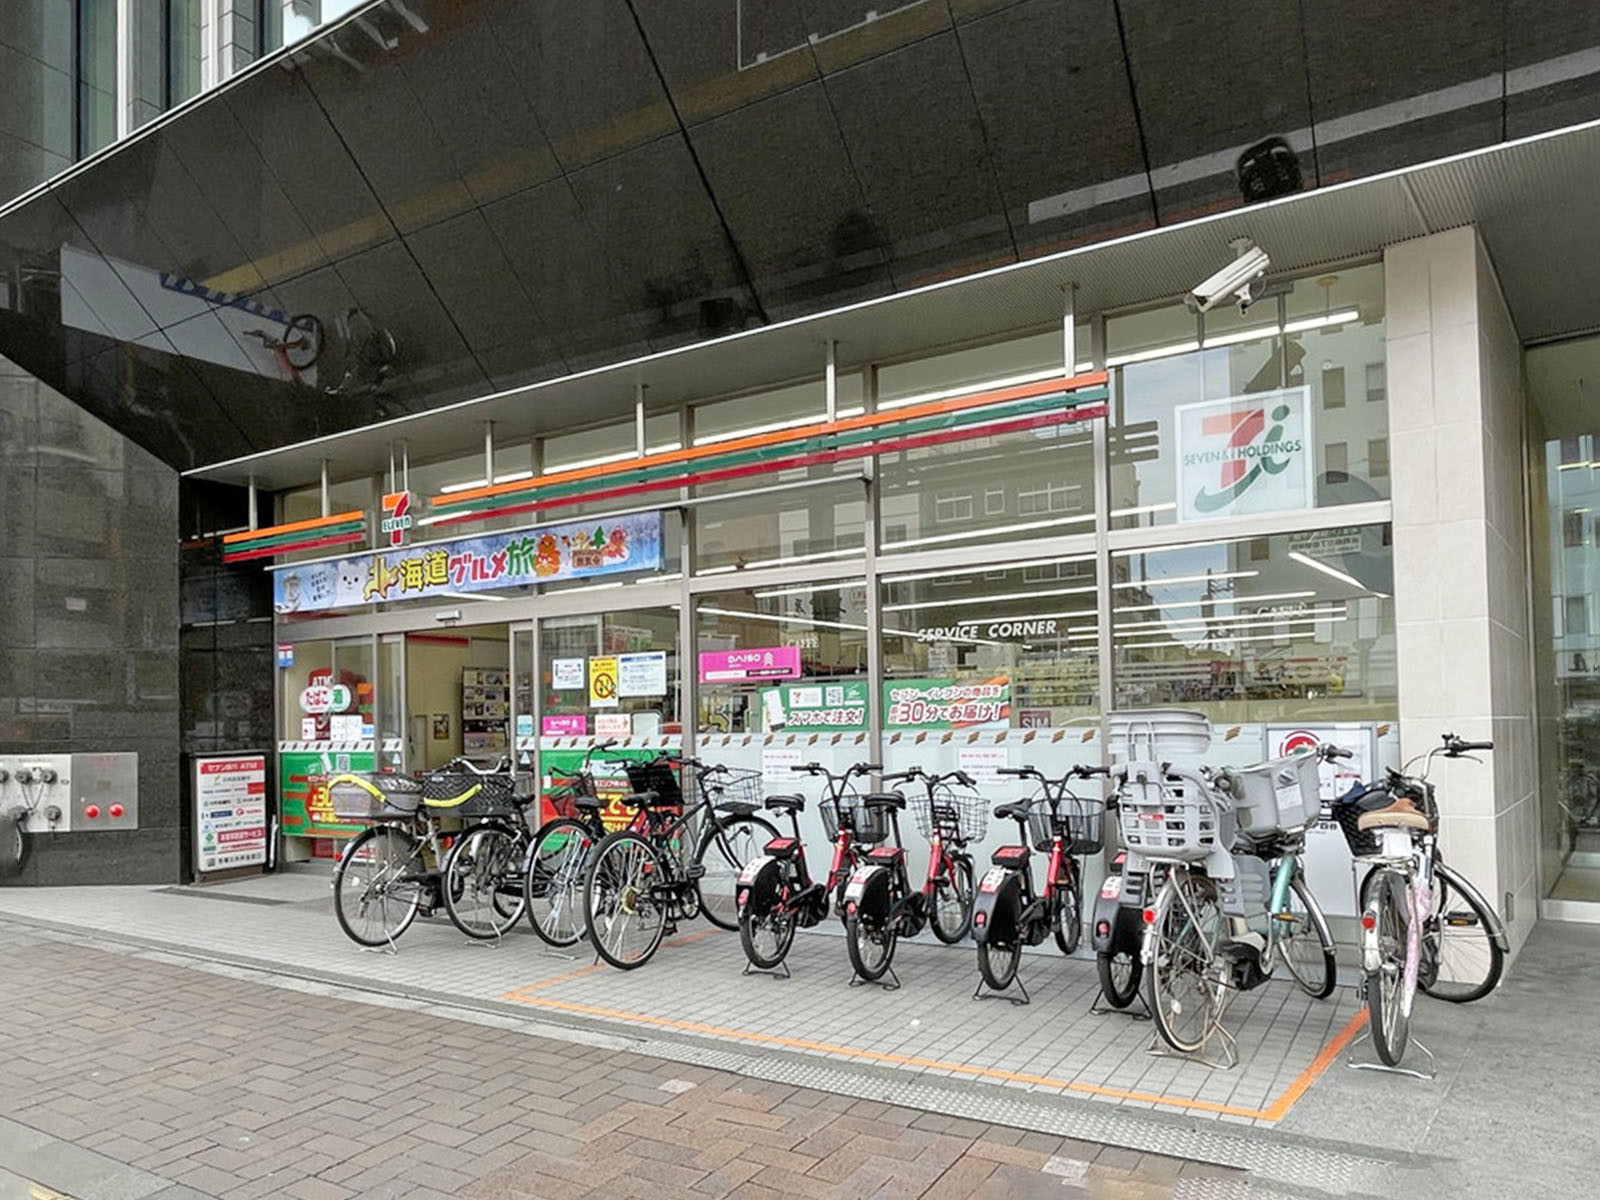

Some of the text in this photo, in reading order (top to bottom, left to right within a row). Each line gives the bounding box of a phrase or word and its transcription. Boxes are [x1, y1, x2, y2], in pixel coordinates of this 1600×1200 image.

[1237, 440, 1302, 459] HOLDINGS
[917, 621, 1057, 642] SERVICE CORNER
